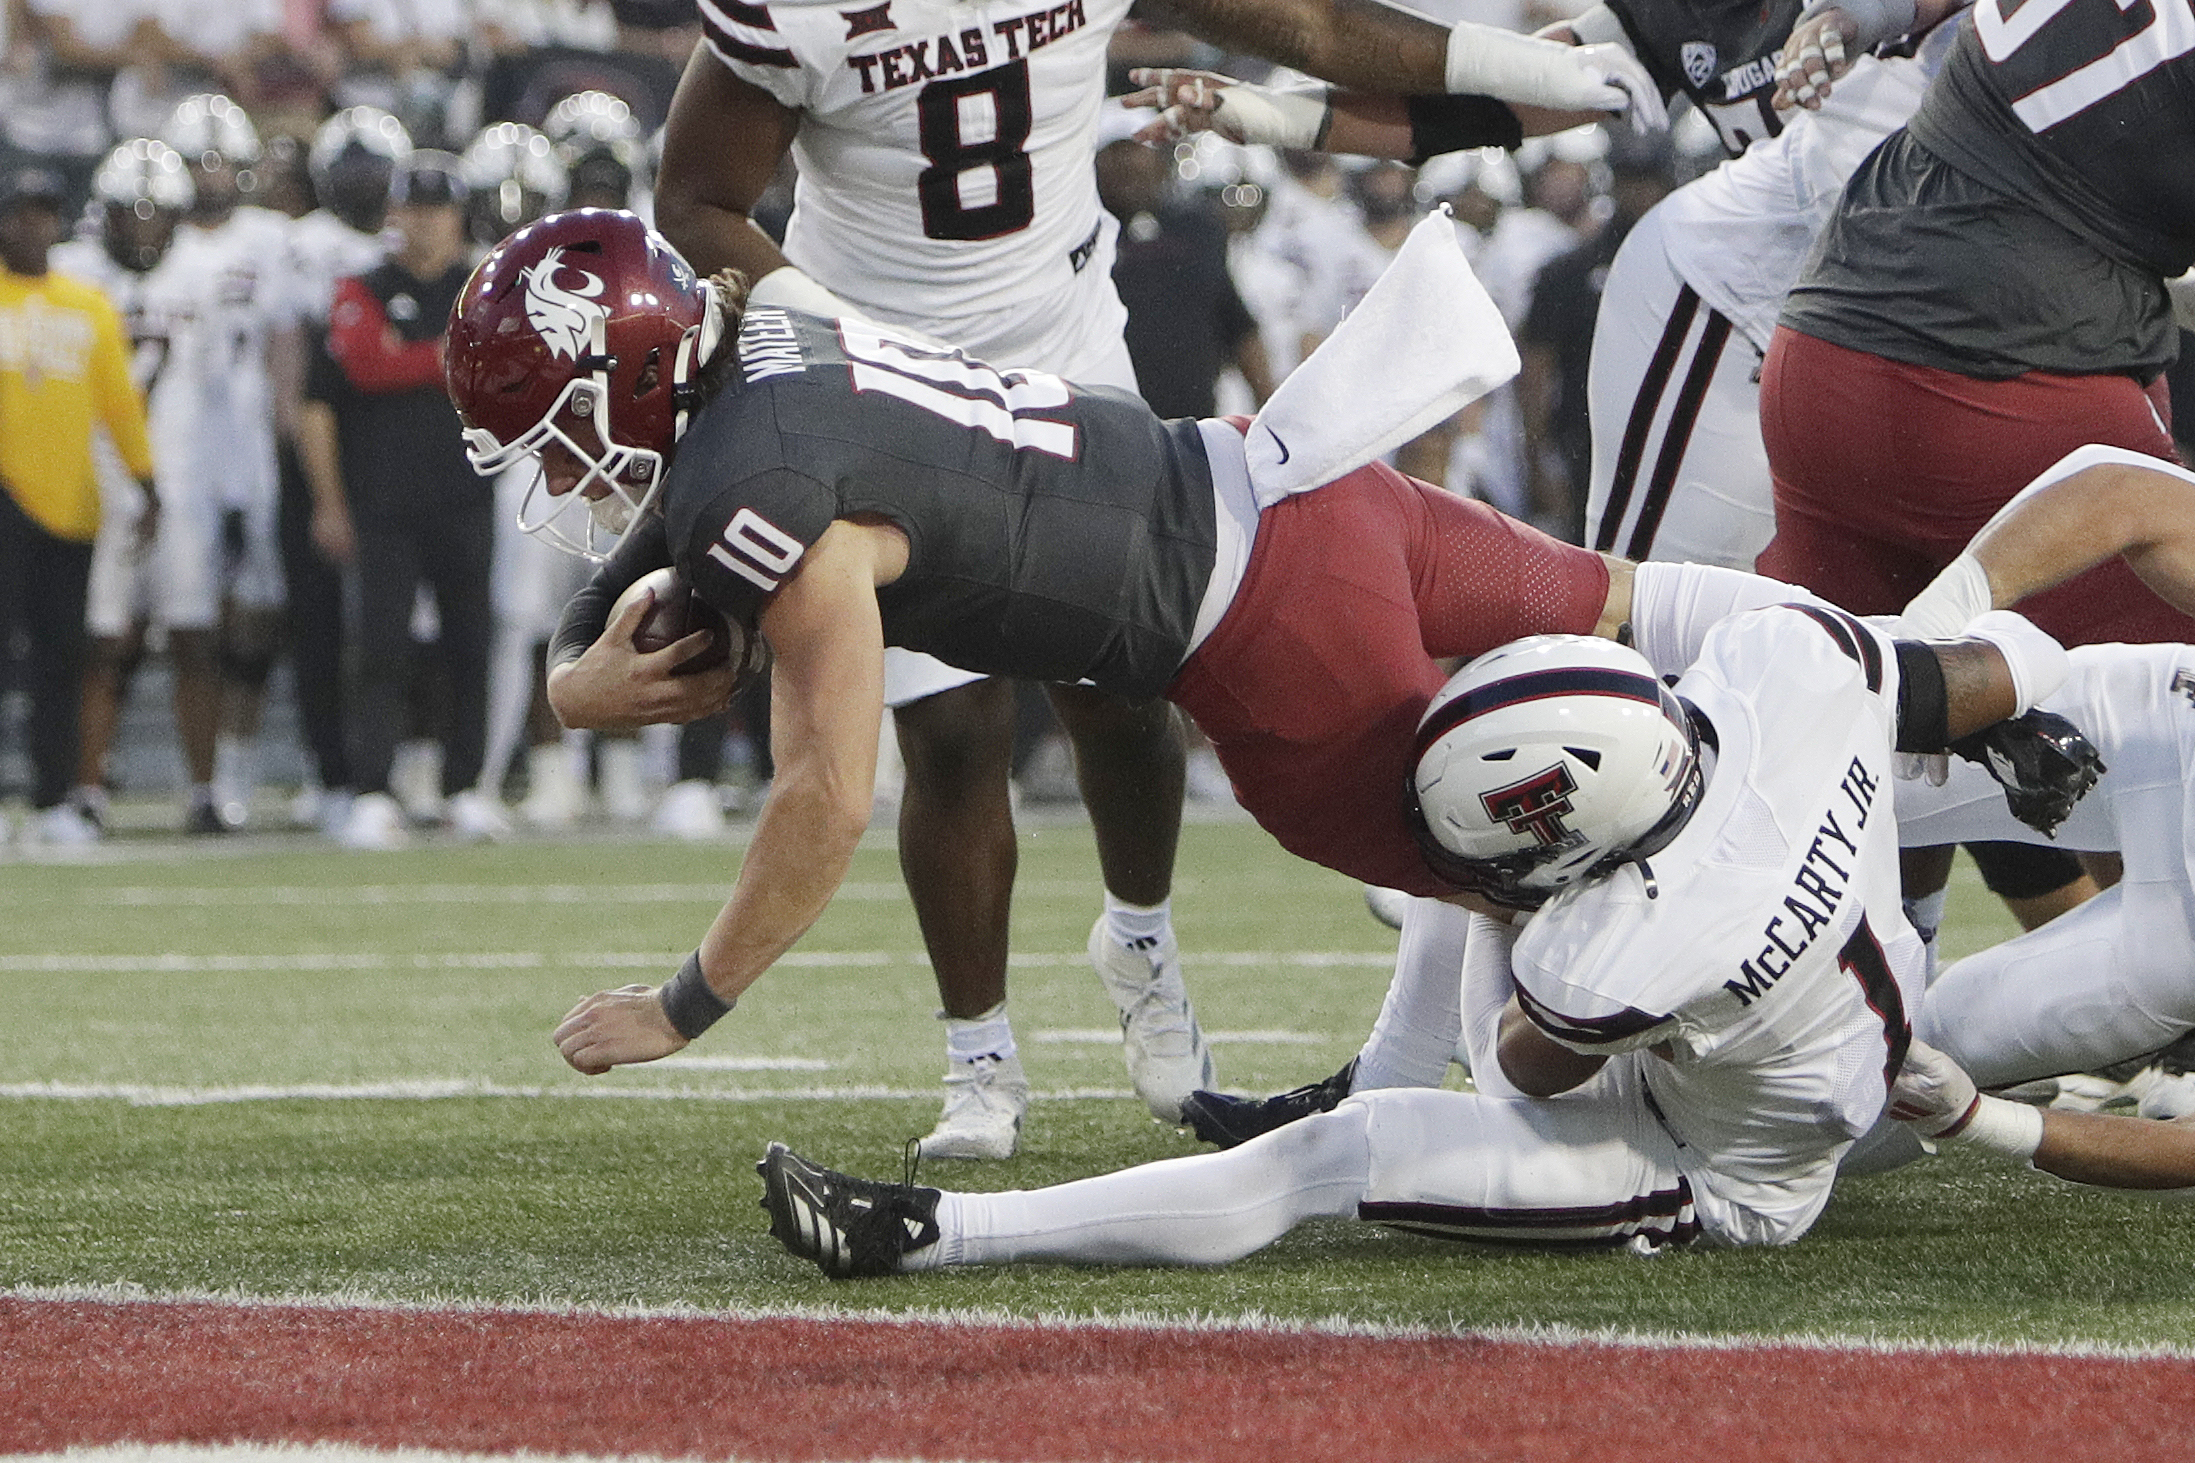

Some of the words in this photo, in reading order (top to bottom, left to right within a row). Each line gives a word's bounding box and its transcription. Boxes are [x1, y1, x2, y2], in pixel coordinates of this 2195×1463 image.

[847, 27, 989, 94] TEXAS
[993, 0, 1086, 60] TECH
[917, 57, 1034, 240] 8
[834, 316, 1081, 463] 10
[705, 505, 805, 592] 10
[1722, 809, 1857, 1006] McCARTY
[1840, 755, 1880, 831] JR.
[1837, 906, 1912, 1098] 1
